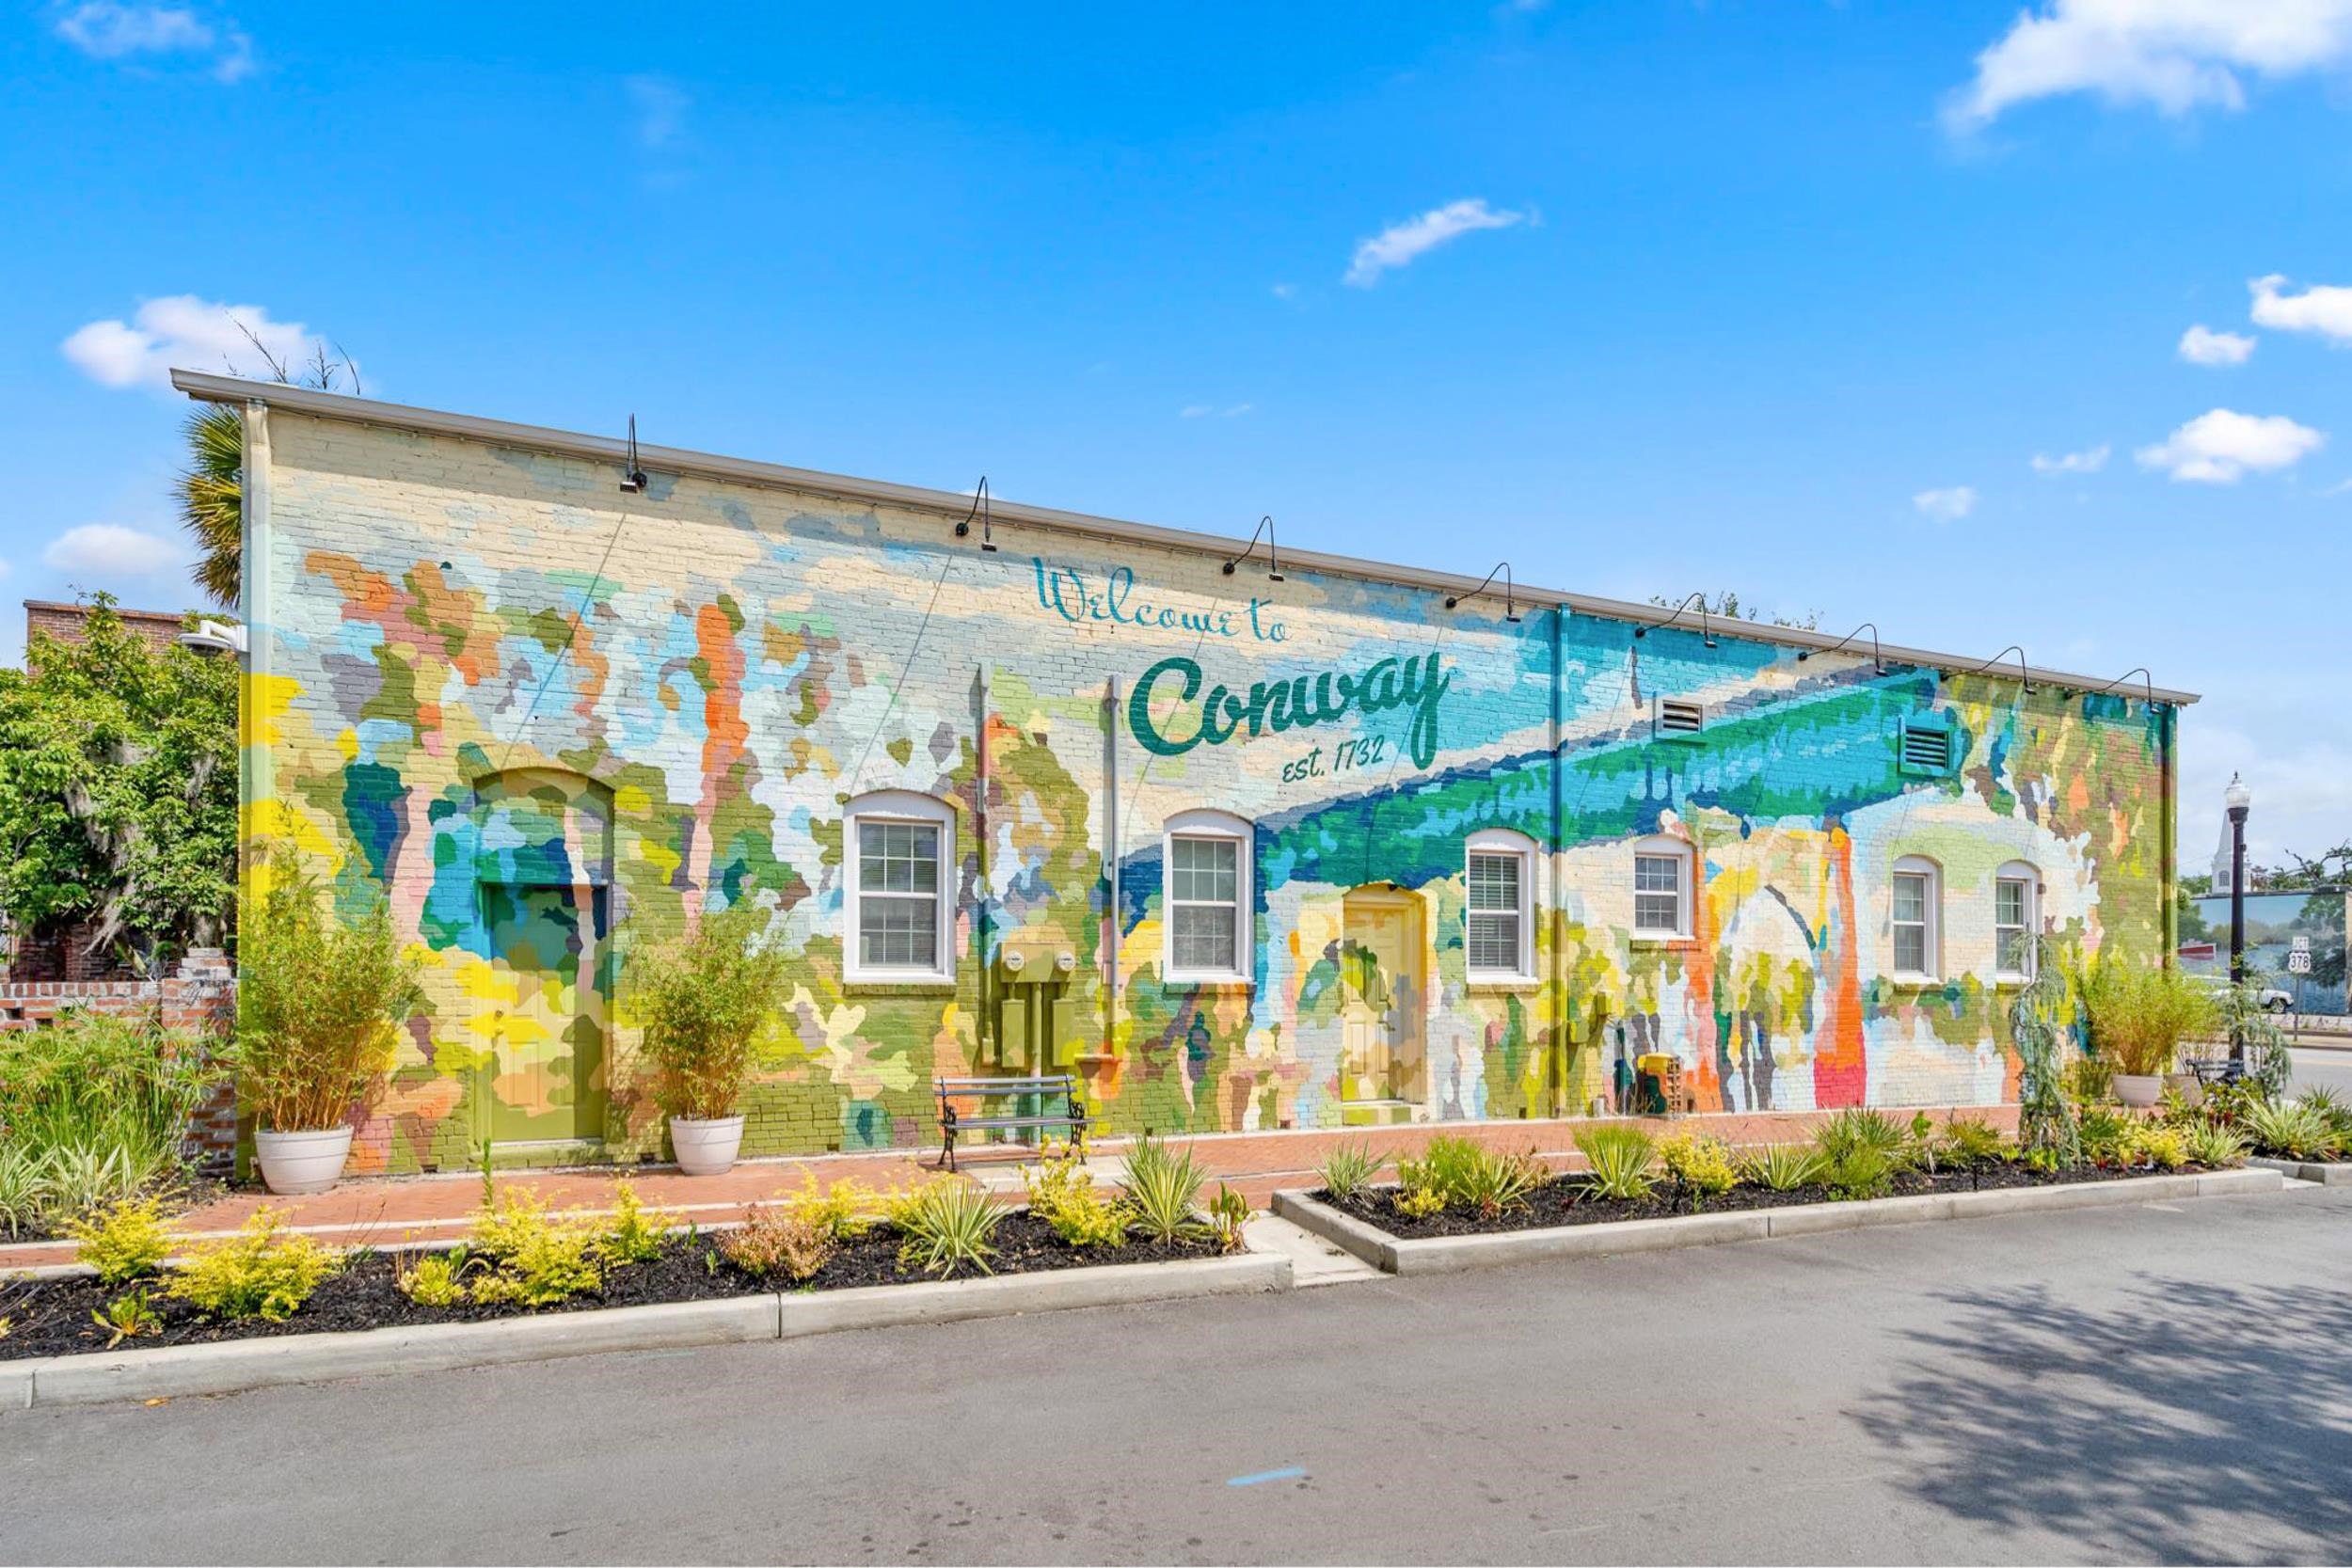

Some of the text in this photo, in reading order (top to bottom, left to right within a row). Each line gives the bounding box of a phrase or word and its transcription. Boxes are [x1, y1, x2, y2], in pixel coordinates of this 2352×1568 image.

[1033, 557, 1293, 641] Welcome to
[1129, 652, 1450, 769] Conway
[1282, 735, 1385, 783] est. 1732
[2290, 955, 2310, 969] 378
